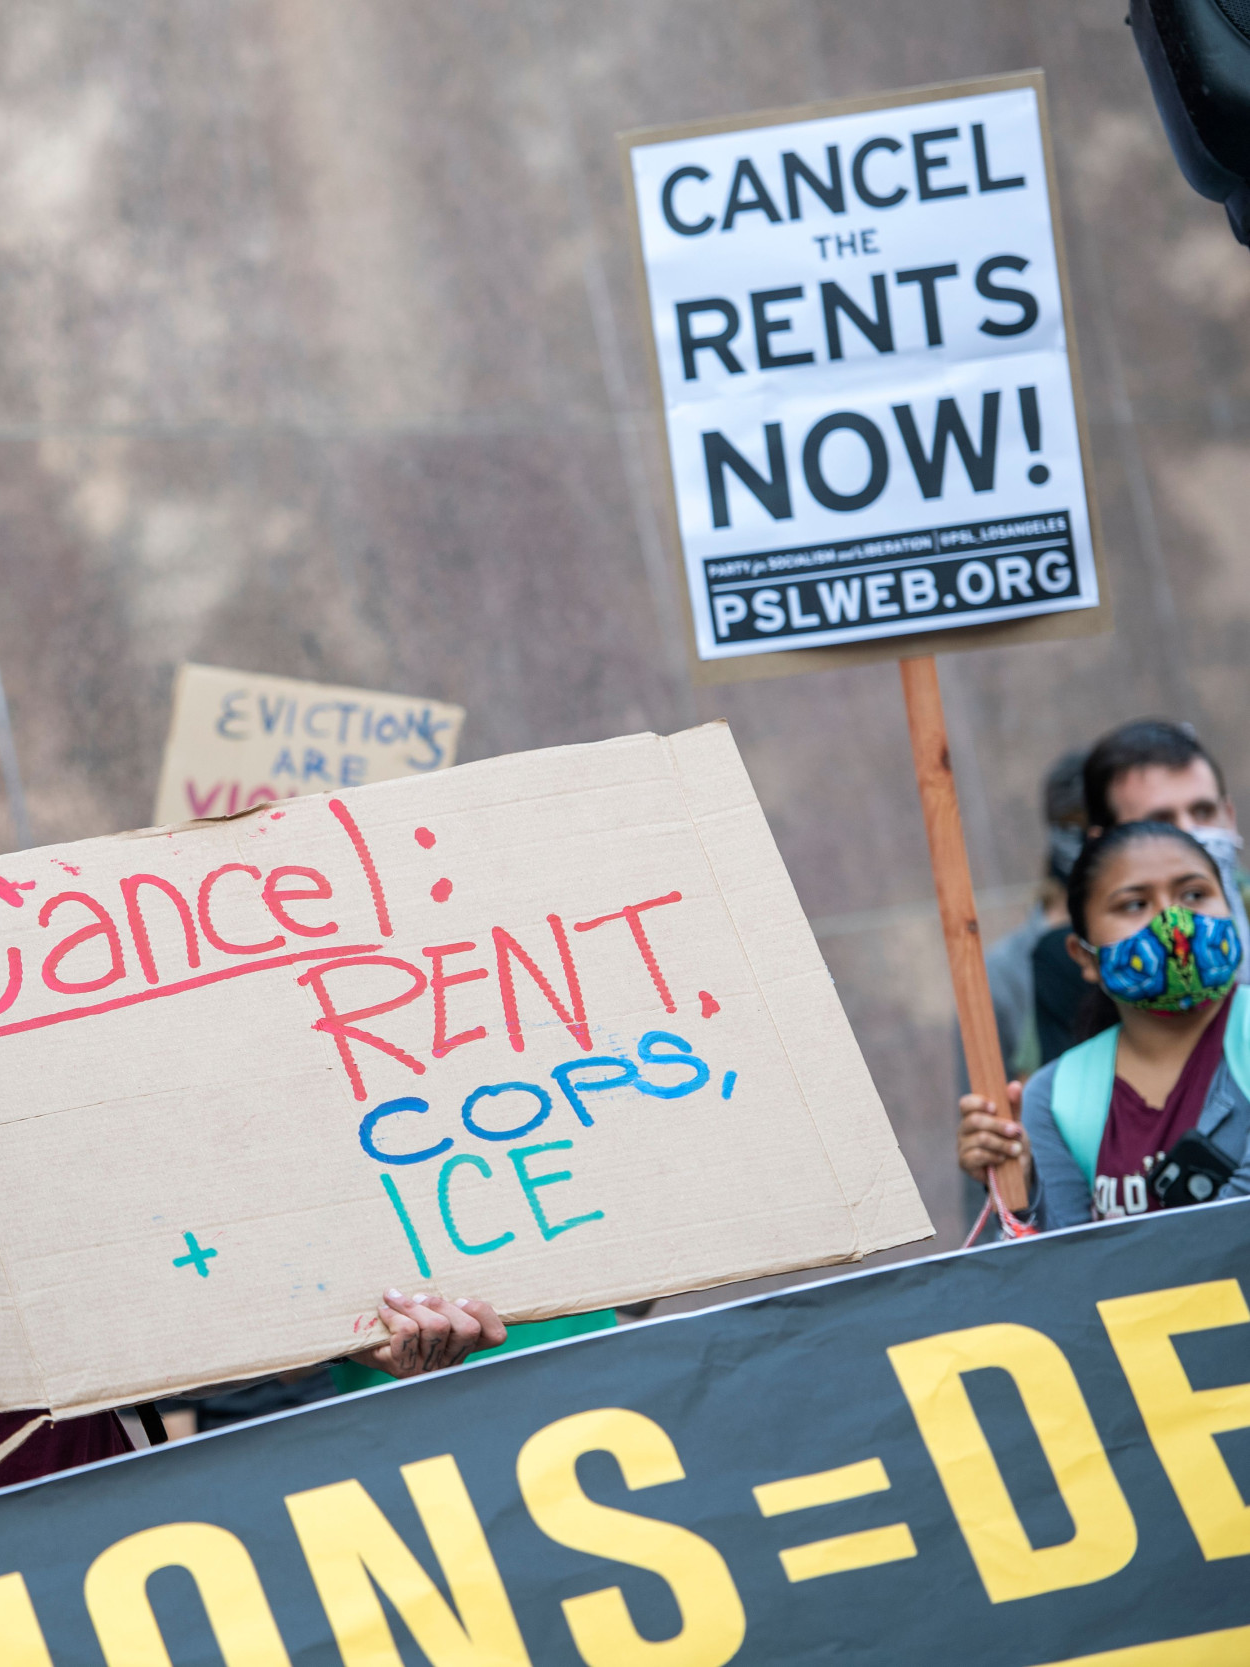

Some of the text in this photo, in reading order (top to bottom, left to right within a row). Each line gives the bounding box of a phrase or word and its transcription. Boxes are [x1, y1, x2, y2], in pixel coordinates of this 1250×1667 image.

[662, 122, 1027, 237] CANCEL
[812, 228, 881, 262] THE
[675, 254, 1041, 382] RENTS
[701, 385, 1051, 530] NOW!
[712, 550, 1073, 639] PSLWEB.ORG
[217, 690, 451, 771] EVICTIONS
[272, 748, 367, 787] ARE
[359, 1030, 738, 1165] COPS,
[380, 1138, 604, 1279] ICE
